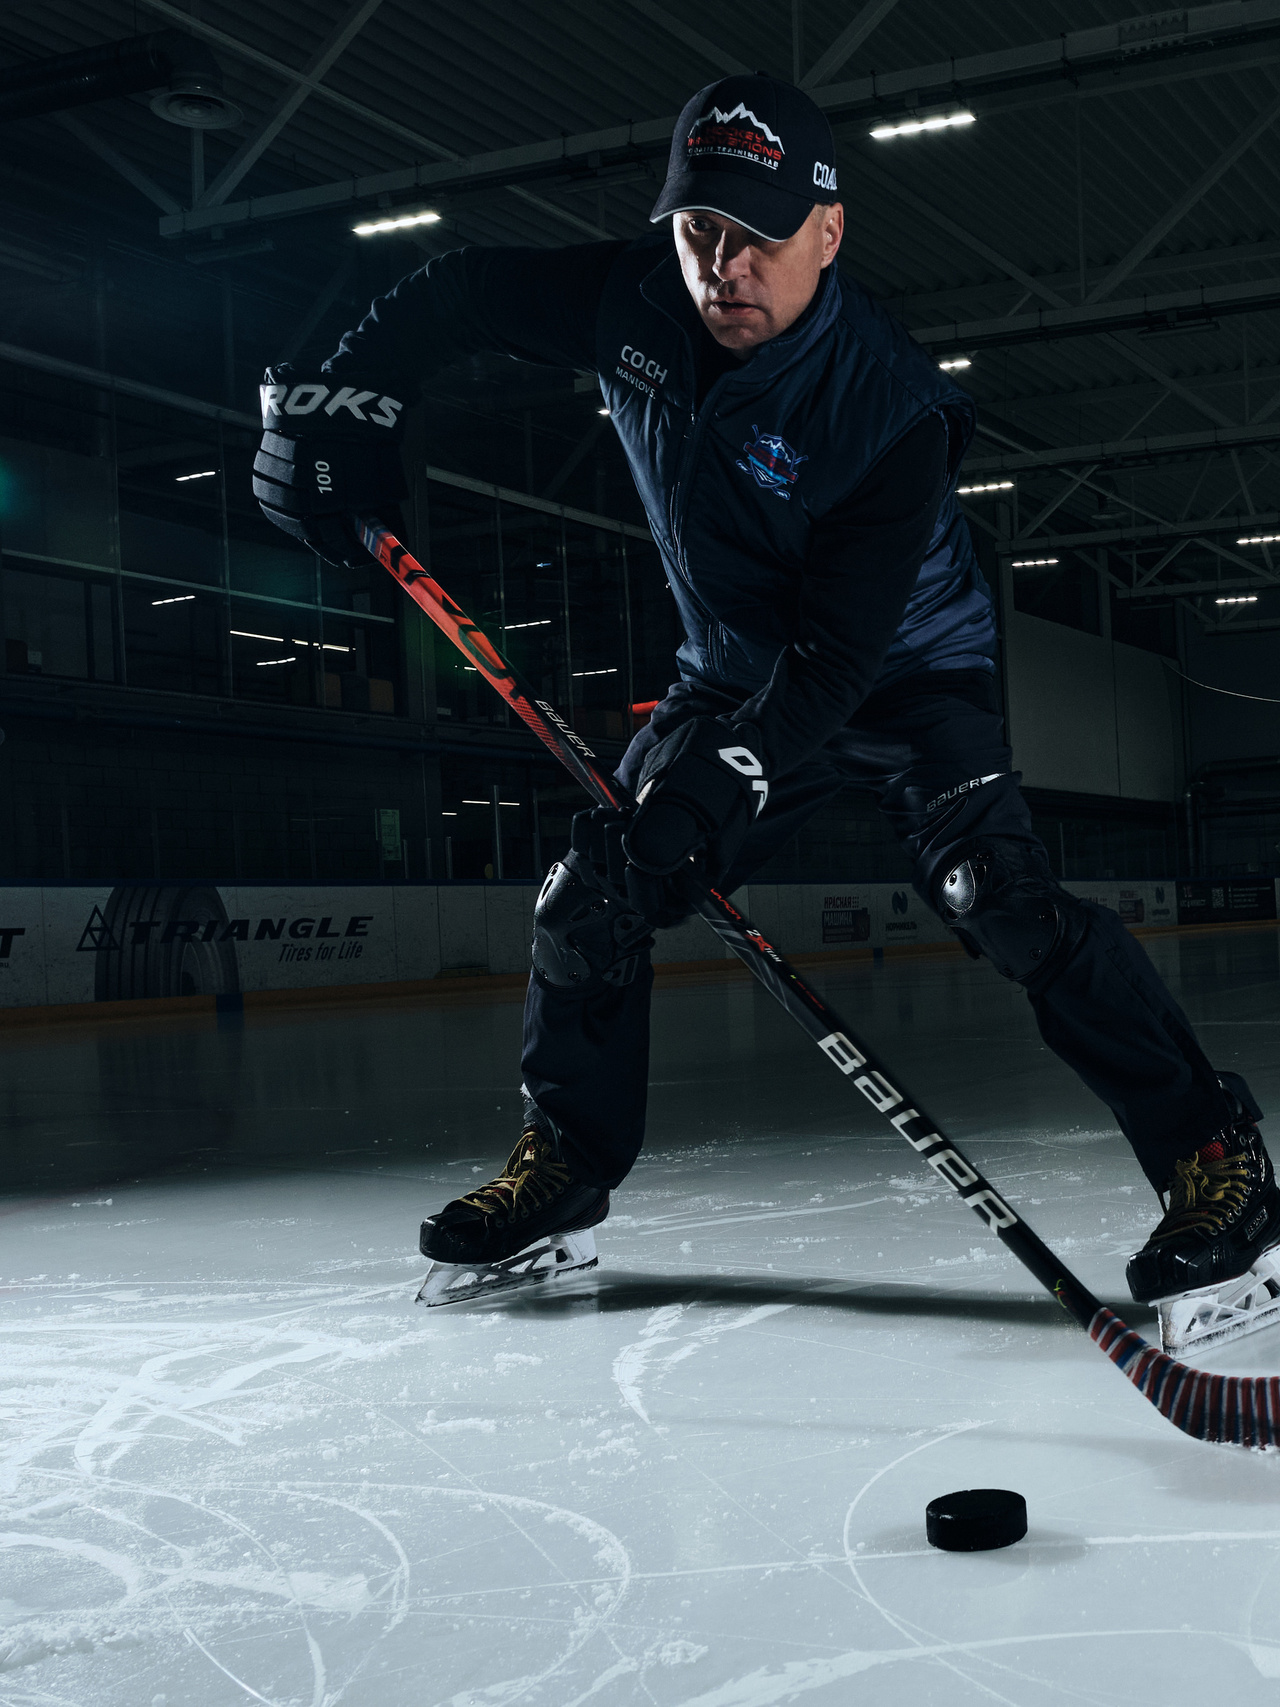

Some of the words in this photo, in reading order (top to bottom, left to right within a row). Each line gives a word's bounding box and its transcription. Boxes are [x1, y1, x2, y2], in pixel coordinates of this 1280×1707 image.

[705, 126, 765, 144] HOCKEY
[717, 146, 760, 160] TRAINING
[763, 156, 779, 168] LAB
[620, 345, 668, 384] COCH
[314, 460, 334, 495] 100
[534, 699, 597, 759] BAUER
[926, 778, 981, 813] BAUER
[129, 916, 374, 944] TRIANGLE
[278, 943, 313, 962] Tires
[315, 942, 336, 960] for
[338, 940, 364, 959] Life
[817, 1031, 1018, 1236] BAUER
